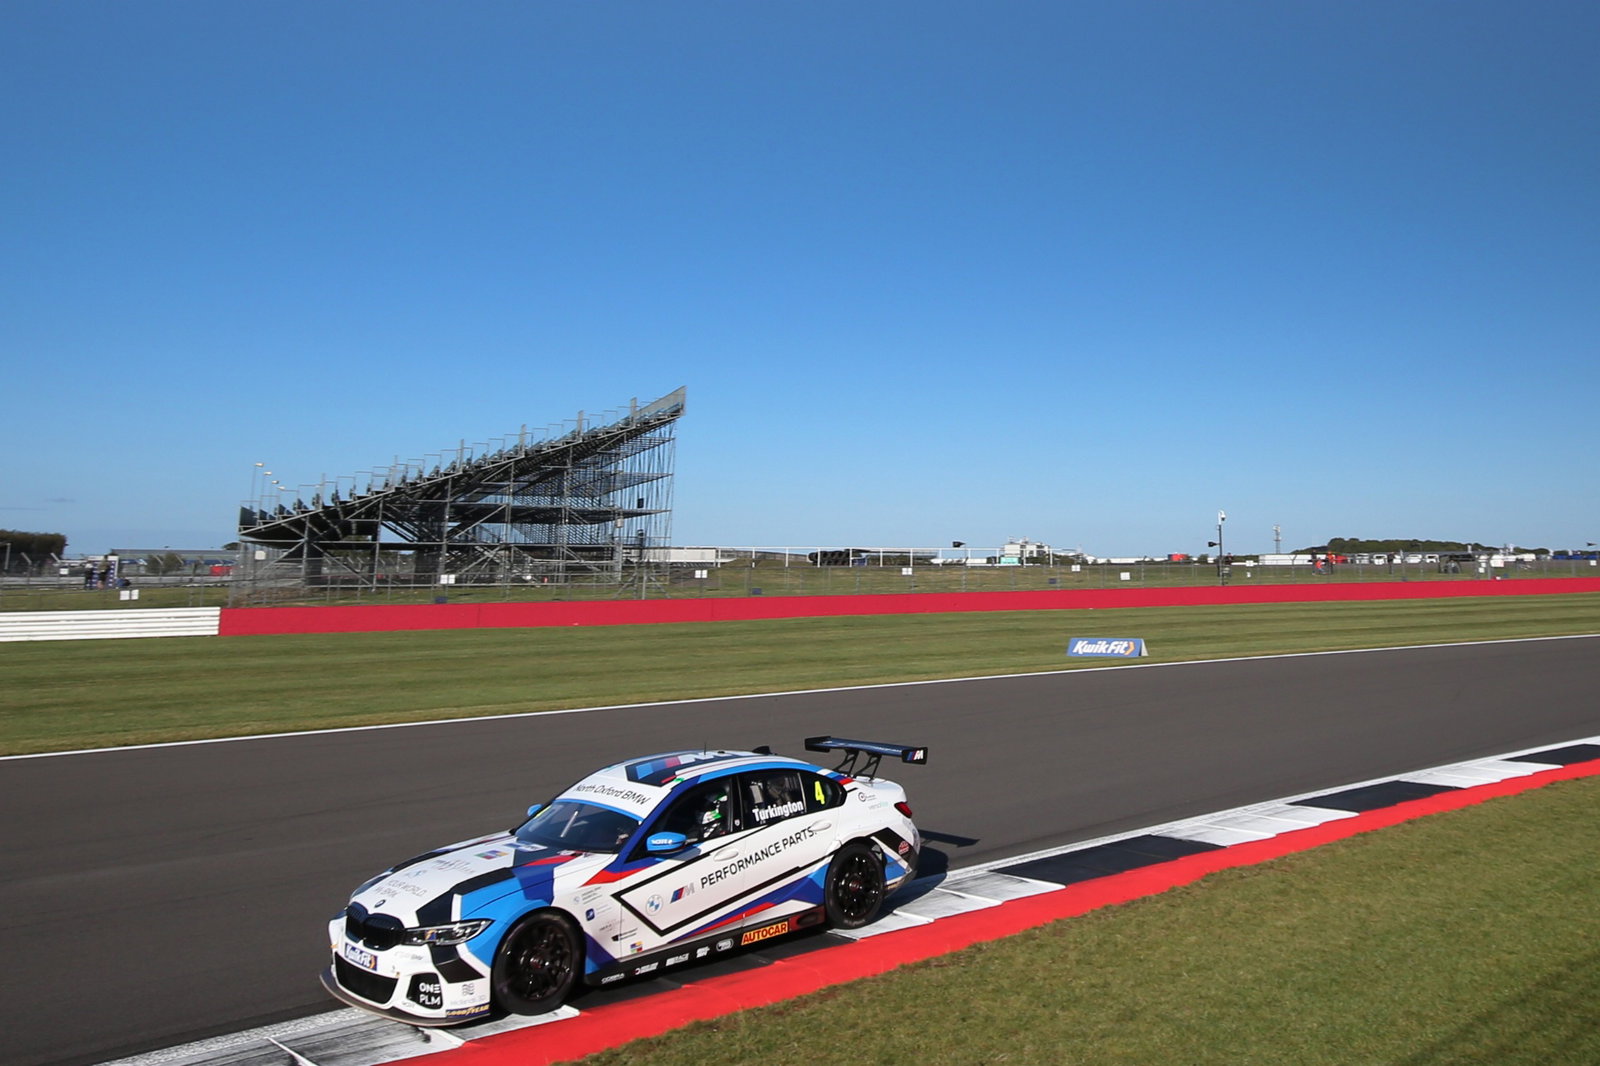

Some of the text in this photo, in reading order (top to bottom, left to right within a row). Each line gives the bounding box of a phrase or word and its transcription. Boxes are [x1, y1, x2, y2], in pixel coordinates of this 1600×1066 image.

[573, 783, 653, 806] North Oxford BMW
[814, 781, 826, 805] 4
[752, 800, 805, 822] Turkington
[700, 841, 782, 889] PERFORMANCE
[742, 922, 788, 944] AUTOCAR
[419, 982, 441, 994] ONE
[419, 995, 441, 1006] PLM
